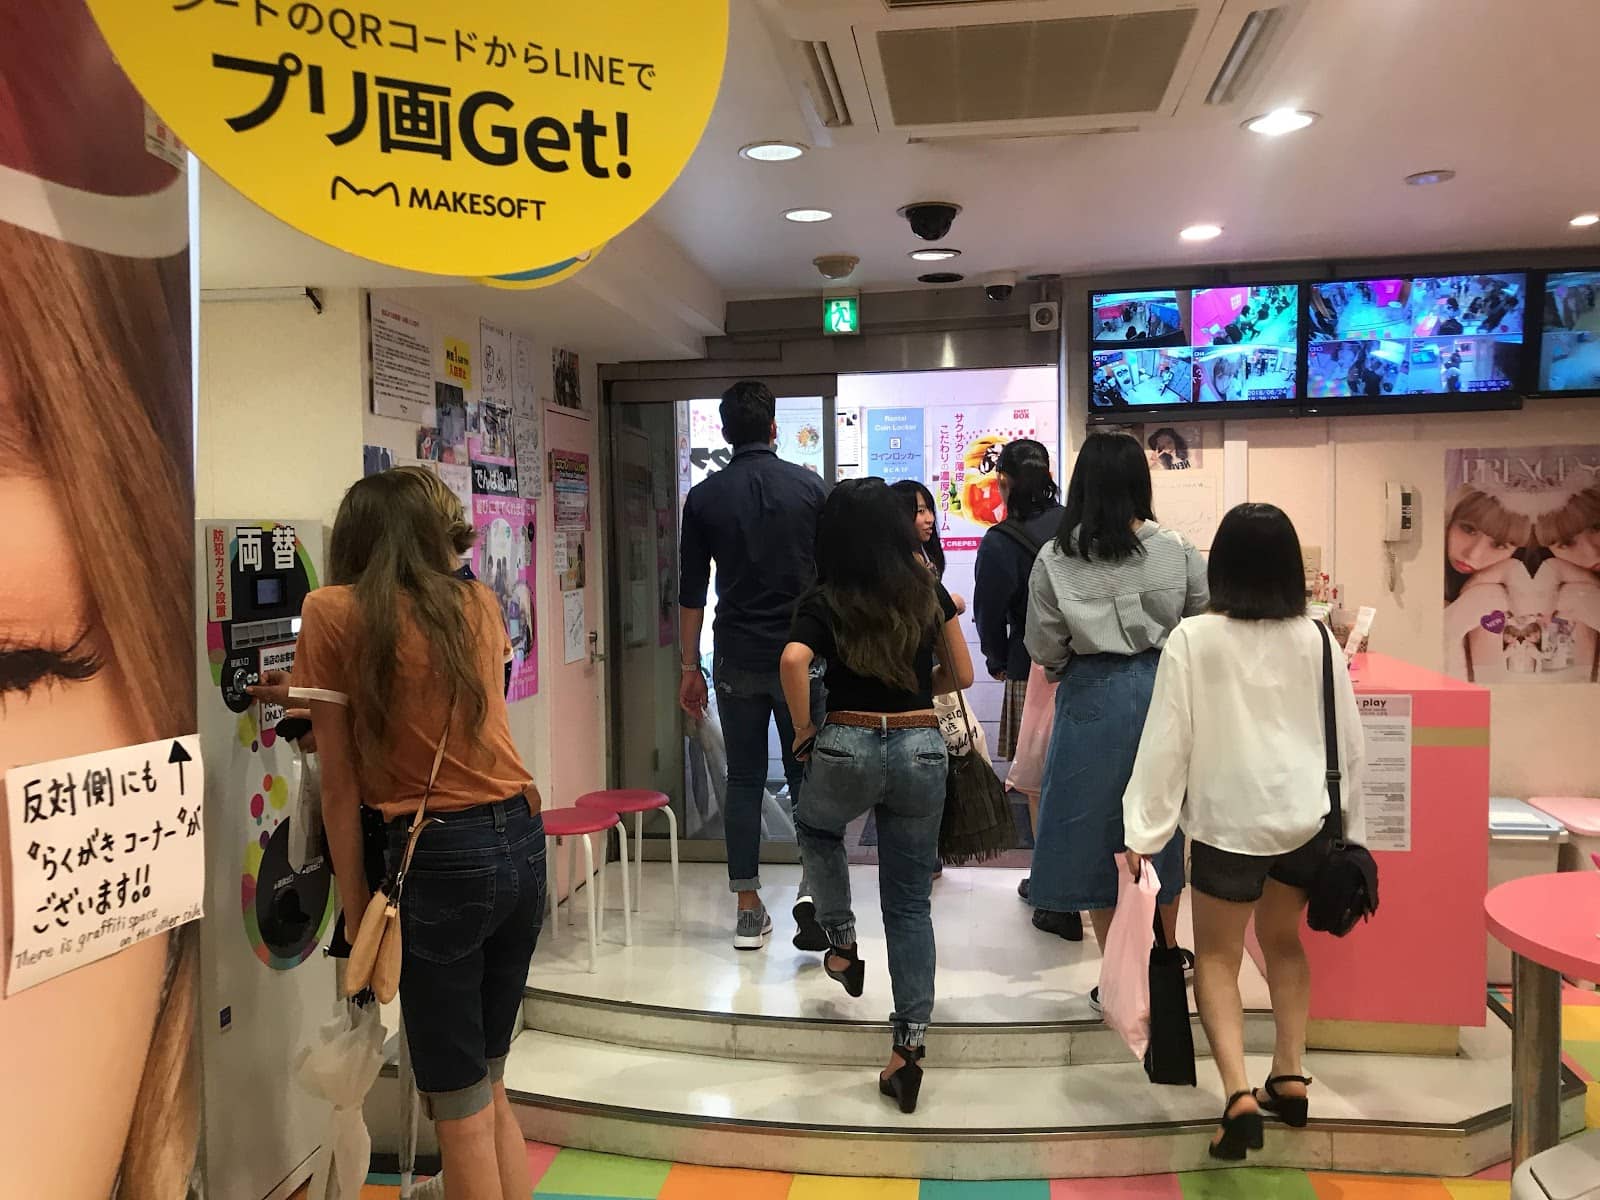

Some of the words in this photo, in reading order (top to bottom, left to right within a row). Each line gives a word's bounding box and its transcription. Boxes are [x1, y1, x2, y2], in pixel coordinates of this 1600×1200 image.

[212, 52, 632, 180] プリ画Get!
[408, 186, 547, 222] MAKESOFT
[1013, 412, 1030, 420] BOX
[871, 451, 921, 461] コインロッカー
[236, 526, 296, 573] 両替
[946, 540, 977, 548] CREPES
[1362, 698, 1386, 708] play
[23, 759, 158, 824] 反対側にも
[15, 945, 54, 970] There
[59, 937, 73, 954] is
[77, 915, 127, 953] graffiti
[127, 908, 159, 930] space
[119, 935, 132, 948] on
[136, 925, 152, 942] the
[154, 913, 180, 934] other
[181, 903, 201, 922] side
